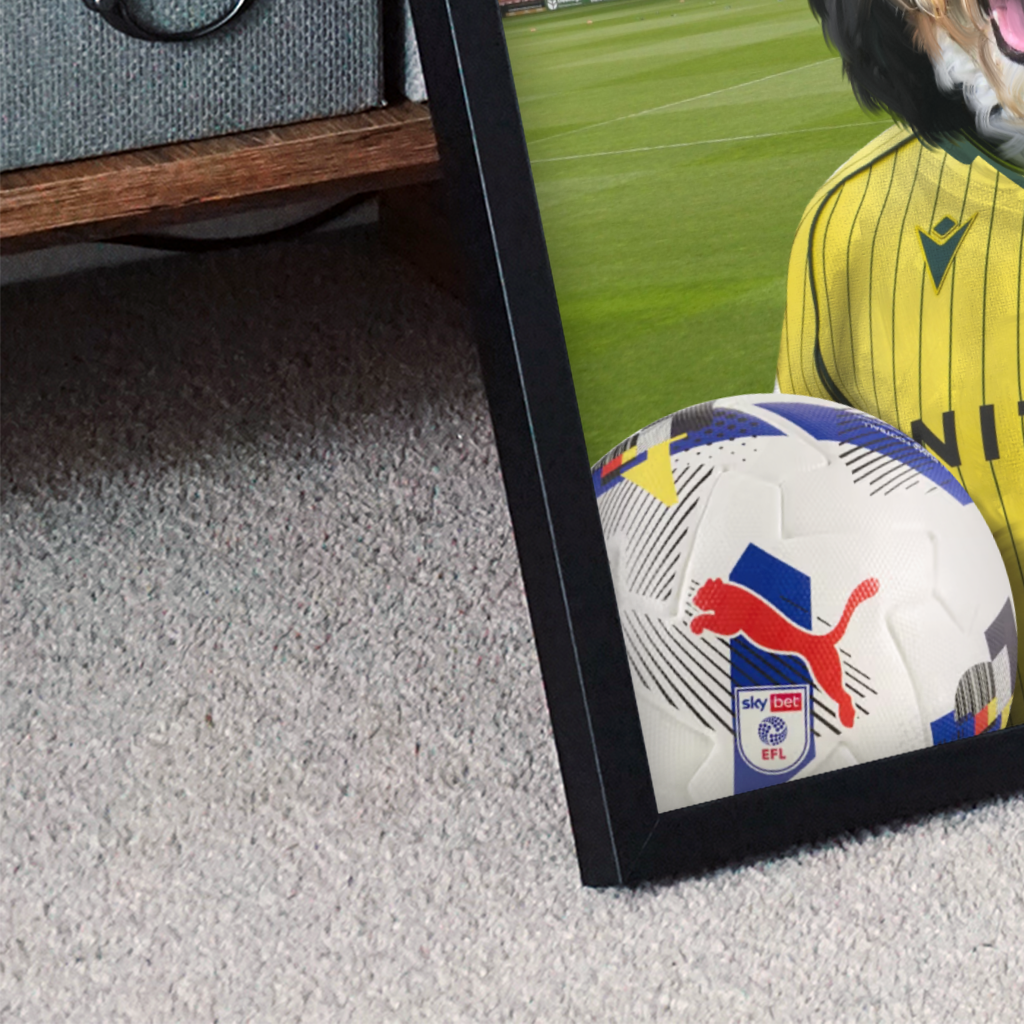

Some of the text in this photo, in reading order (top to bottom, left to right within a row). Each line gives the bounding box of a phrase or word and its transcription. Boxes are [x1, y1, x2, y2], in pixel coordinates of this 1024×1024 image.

[742, 695, 800, 712] sky bet
[761, 747, 787, 761] EFL
